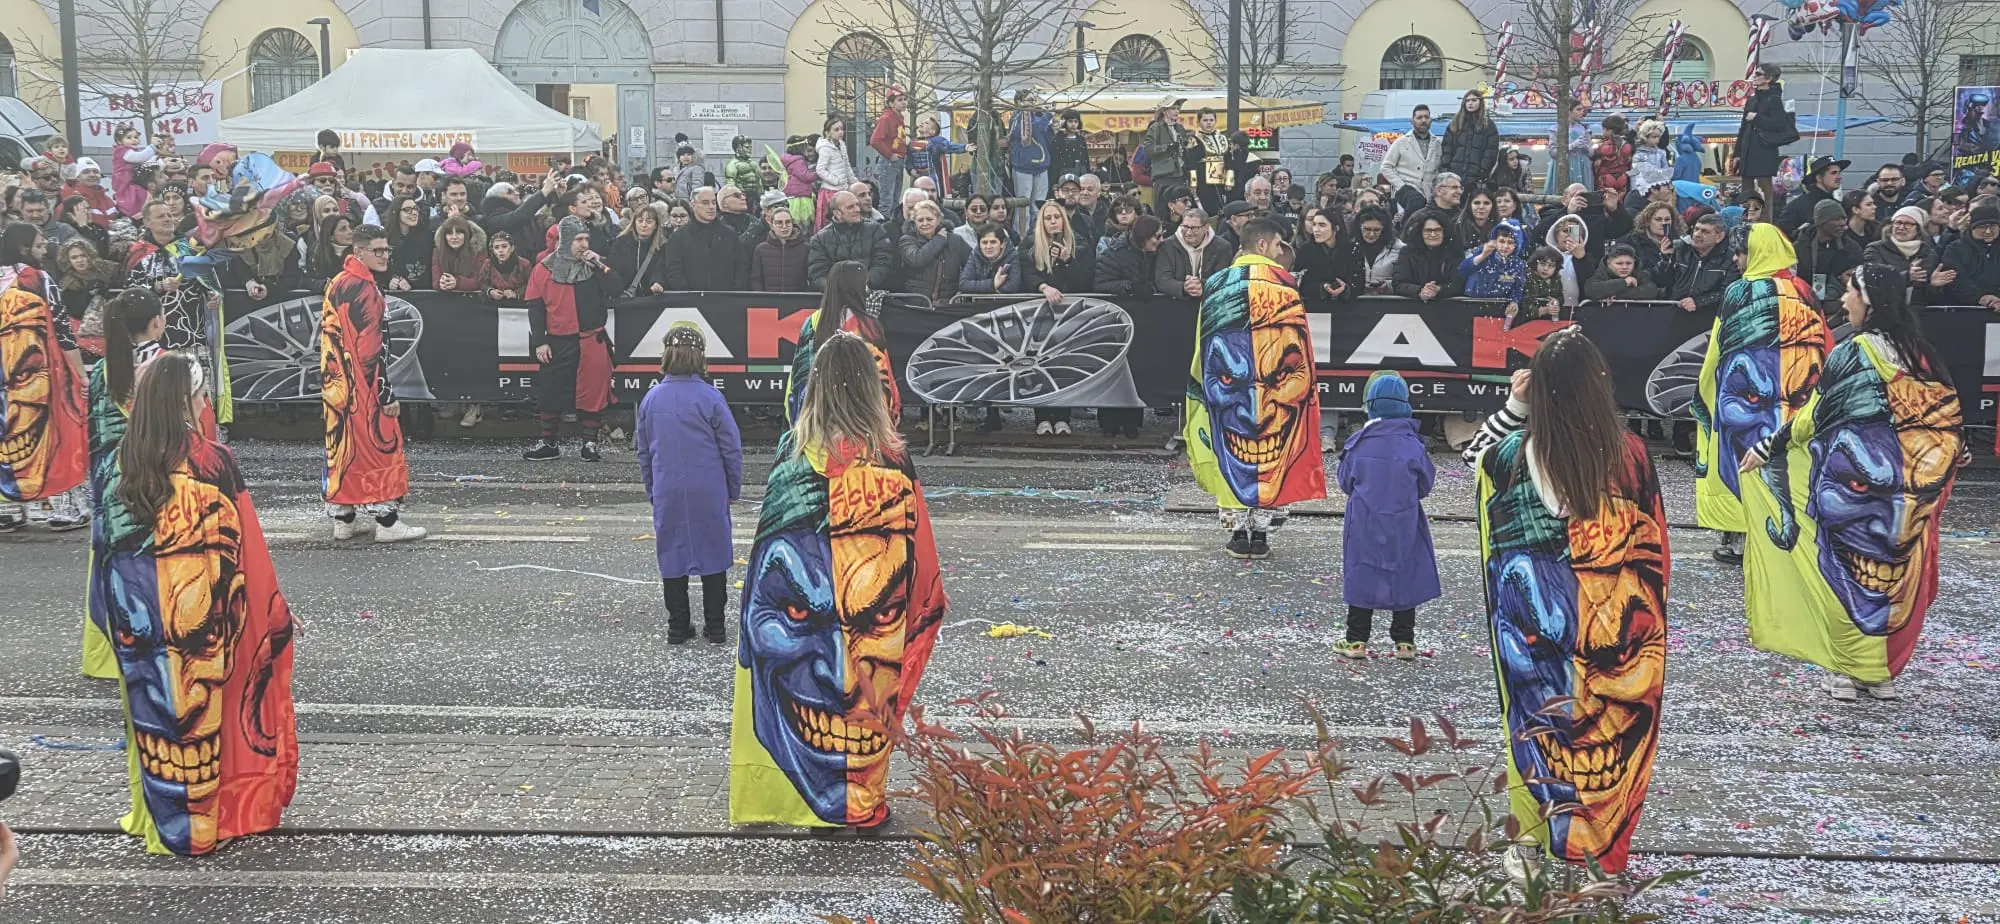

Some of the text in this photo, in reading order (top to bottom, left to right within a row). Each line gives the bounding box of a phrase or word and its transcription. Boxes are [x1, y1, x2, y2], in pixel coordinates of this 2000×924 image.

[108, 91, 177, 112] BATA
[1600, 80, 1656, 108] DEL
[1664, 80, 1754, 108] DOLC
[88, 116, 198, 137] VINZA
[278, 153, 313, 168] CRE
[511, 155, 550, 168] FRITTE
